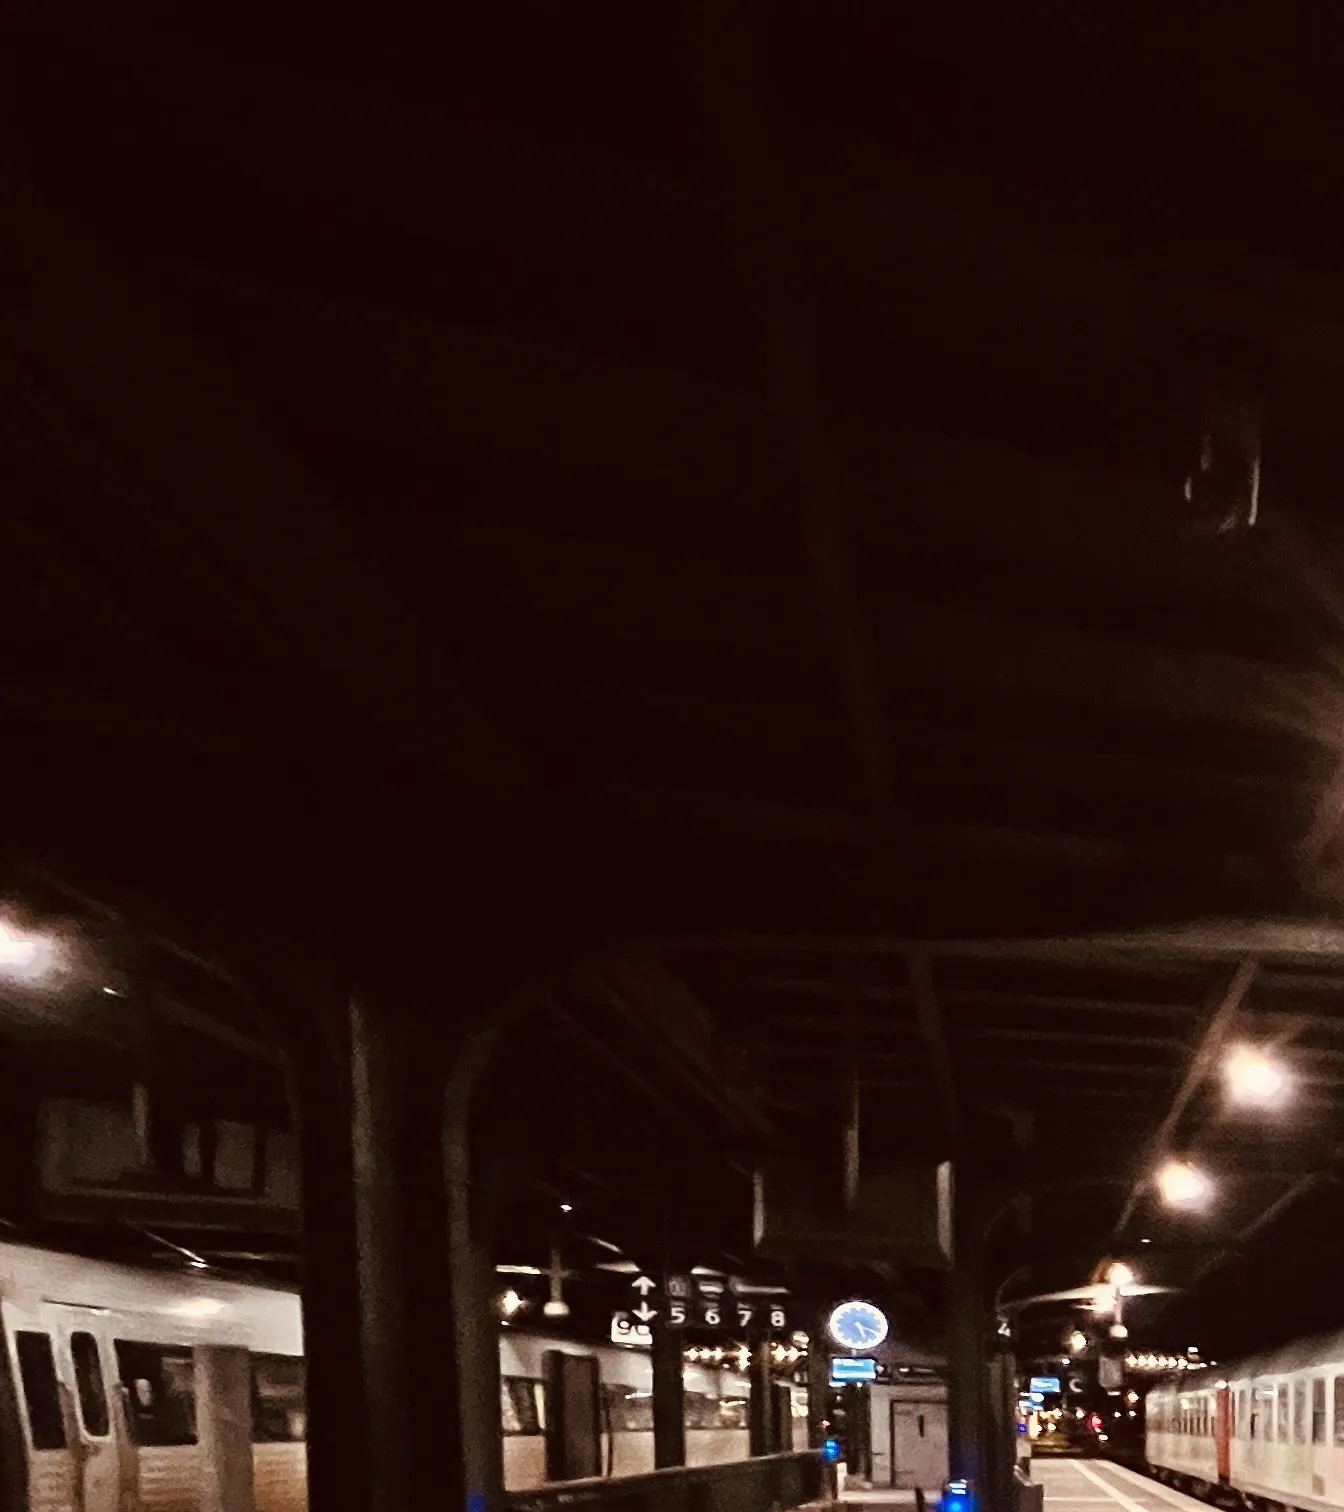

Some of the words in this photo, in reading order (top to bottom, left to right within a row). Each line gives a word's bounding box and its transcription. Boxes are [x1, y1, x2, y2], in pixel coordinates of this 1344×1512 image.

[670, 1307, 686, 1325] 5
[705, 1309, 721, 1325] 6
[737, 1310, 752, 1327] 7
[770, 1310, 786, 1328] 8
